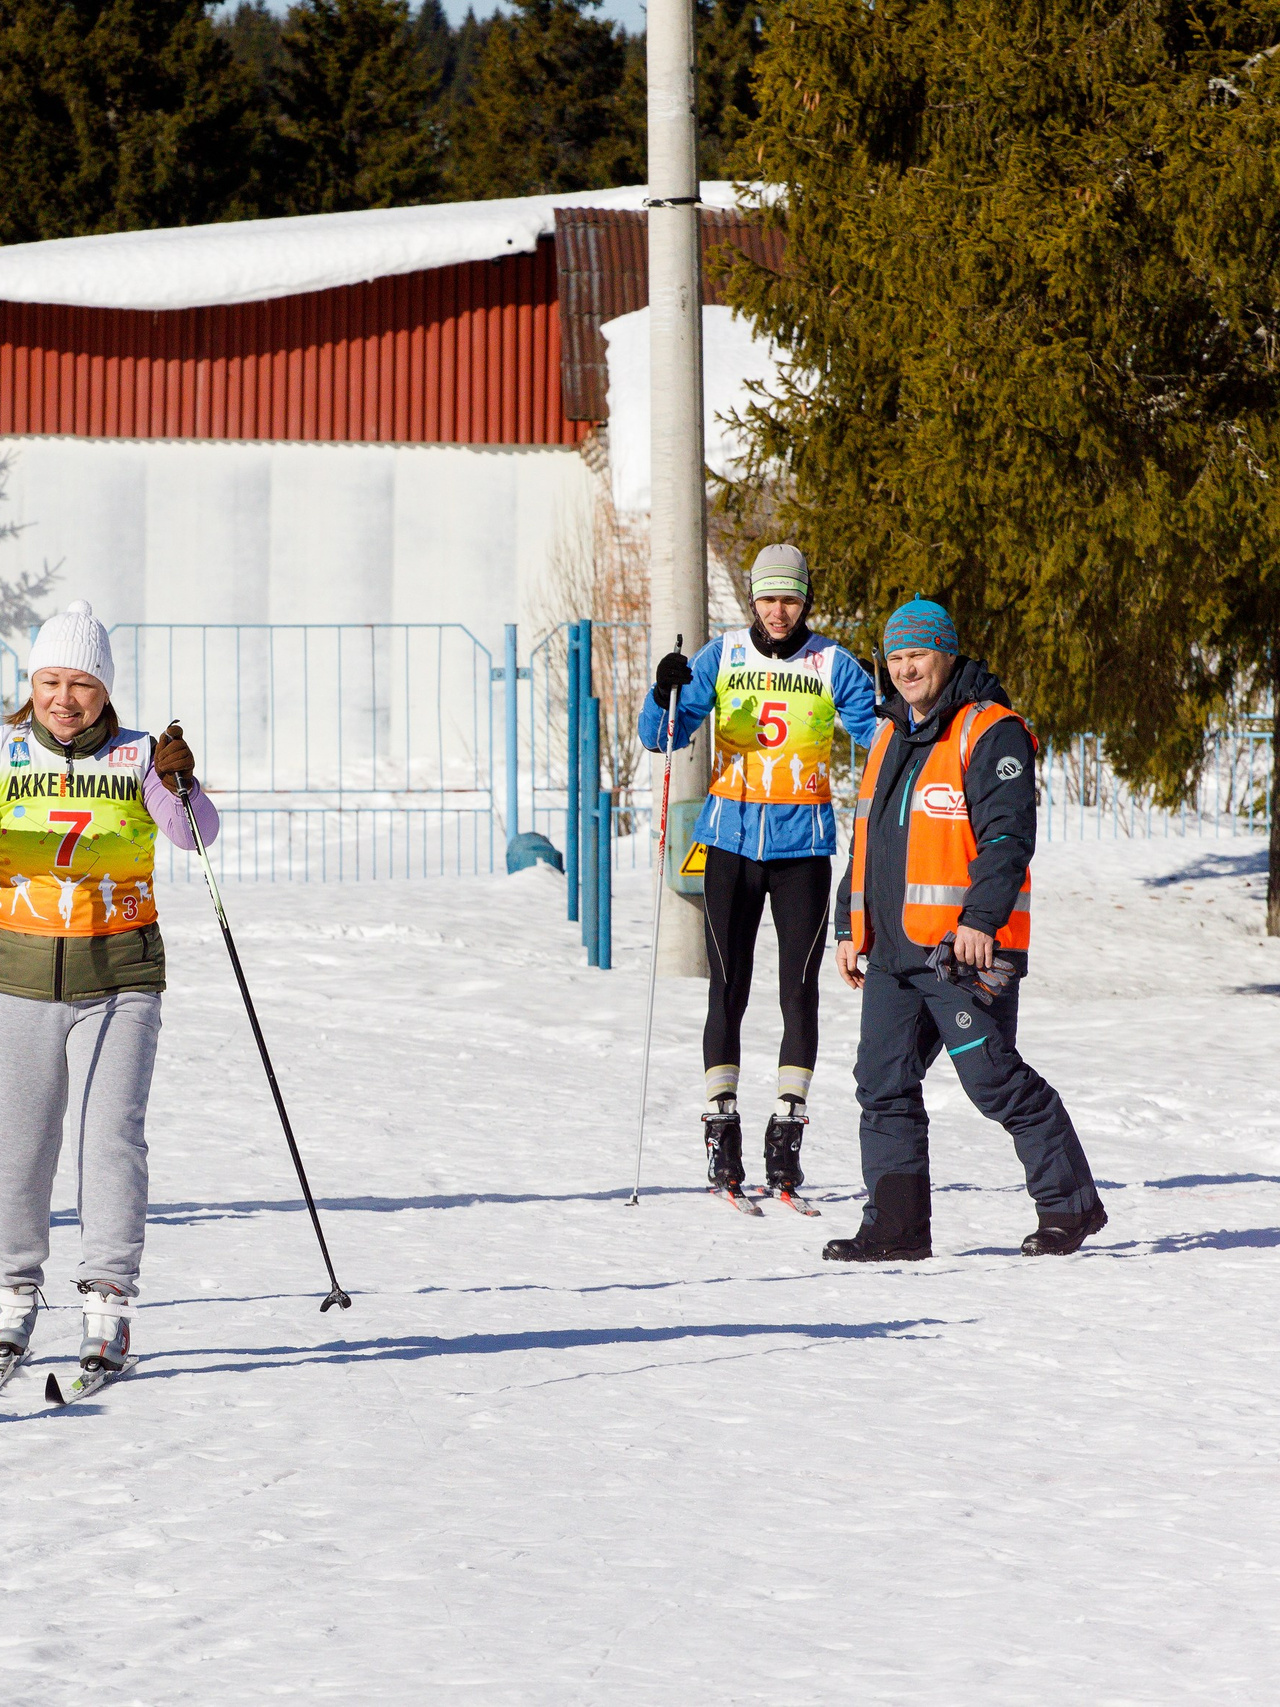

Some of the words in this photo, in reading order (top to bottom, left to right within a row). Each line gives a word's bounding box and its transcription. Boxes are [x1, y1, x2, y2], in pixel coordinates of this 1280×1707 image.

[725, 671, 823, 697] AKKERMANN
[756, 701, 788, 750] 5
[6, 773, 138, 802] AKKERMANN
[805, 773, 817, 793] 4
[48, 810, 93, 868] 7
[123, 895, 139, 921] 3
